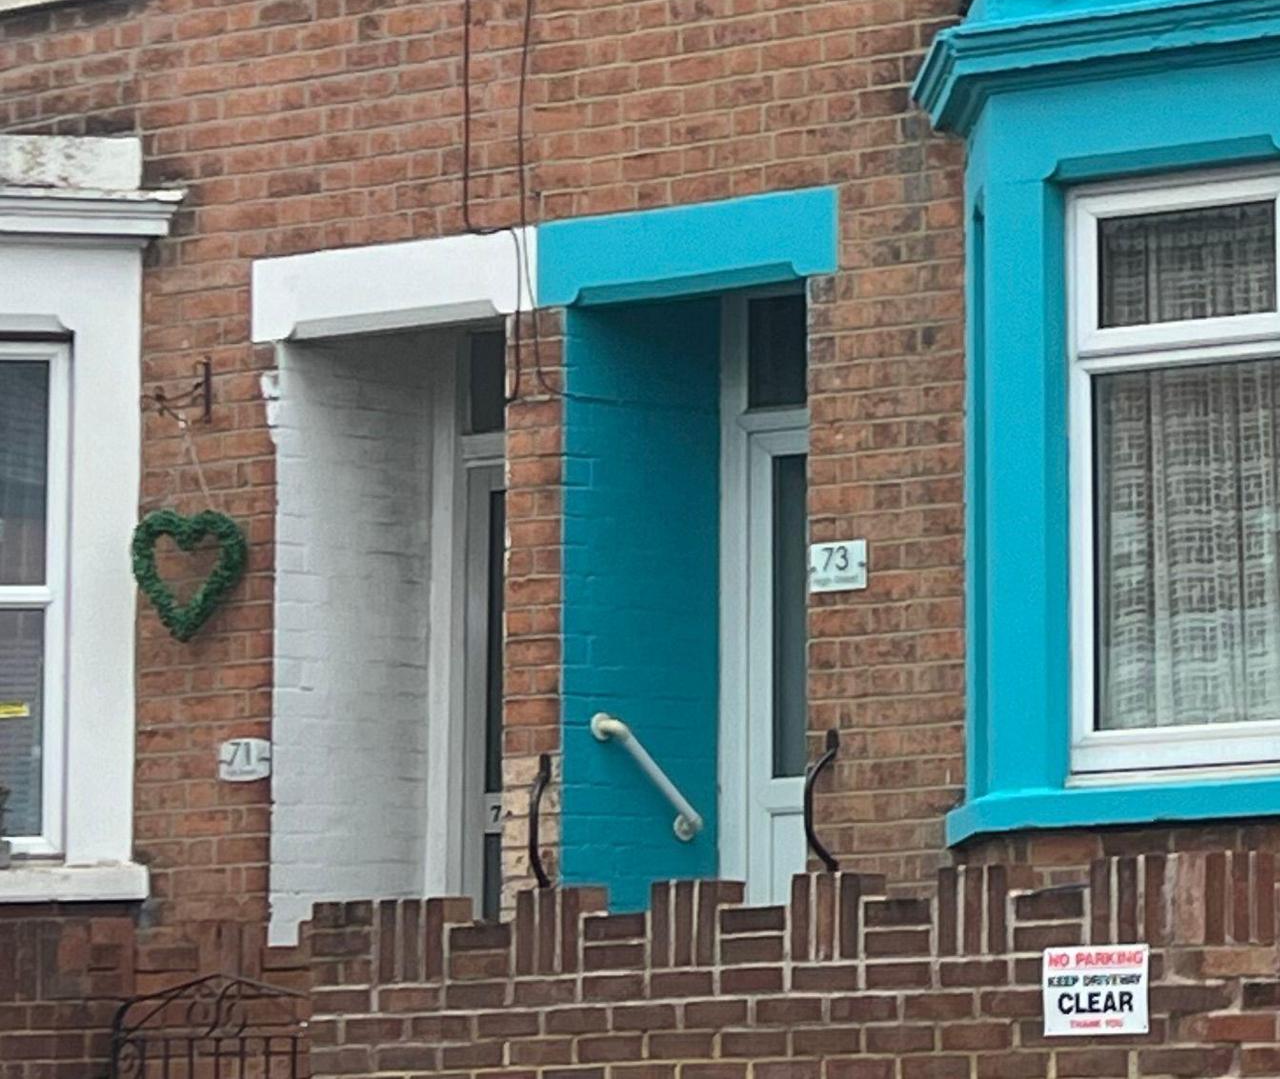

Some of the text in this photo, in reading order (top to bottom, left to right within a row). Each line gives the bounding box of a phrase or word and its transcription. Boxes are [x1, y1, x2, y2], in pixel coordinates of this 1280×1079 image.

[821, 546, 849, 571] 73
[228, 742, 251, 766] 71
[1048, 951, 1143, 967] NO PARKING
[1048, 974, 1142, 987] KEEP DRIVEWAY
[1058, 991, 1134, 1014] CLEAR
[1070, 1019, 1123, 1029] THANK YOU
